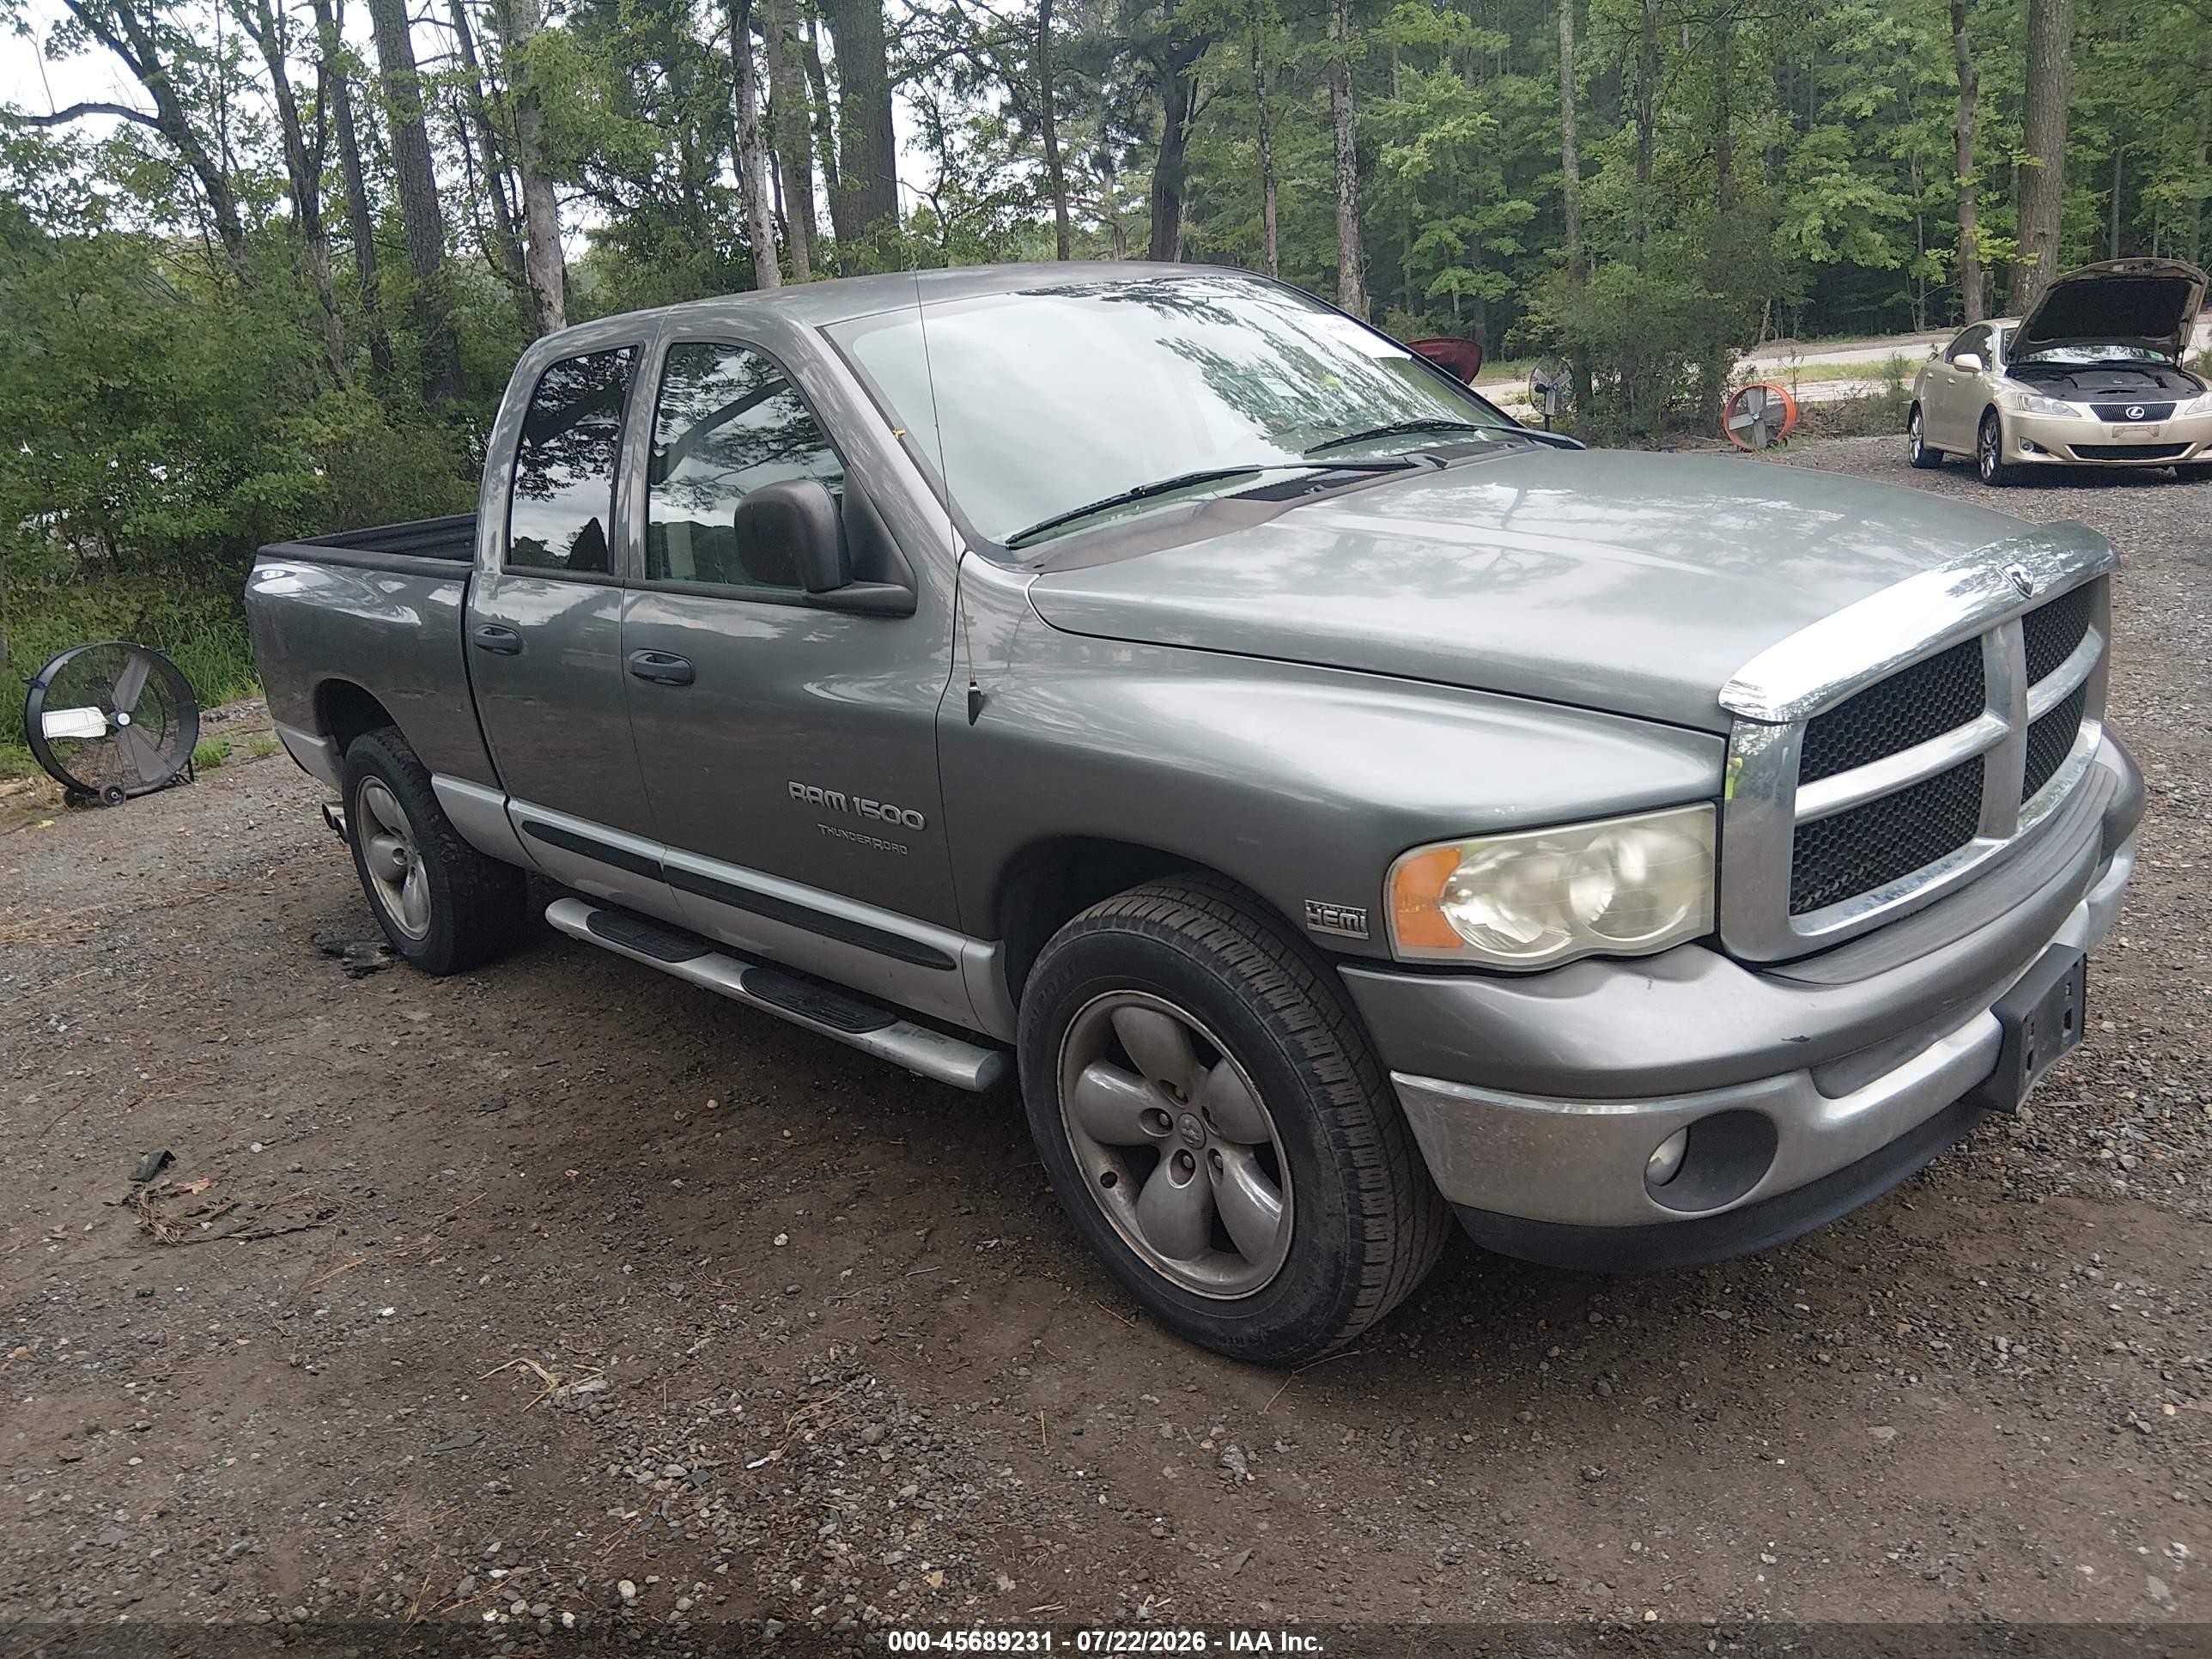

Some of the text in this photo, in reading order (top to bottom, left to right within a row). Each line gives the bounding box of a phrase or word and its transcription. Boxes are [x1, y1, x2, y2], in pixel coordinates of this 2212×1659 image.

[787, 780, 927, 832] RAM 1500
[1305, 905, 1368, 934] HEMI
